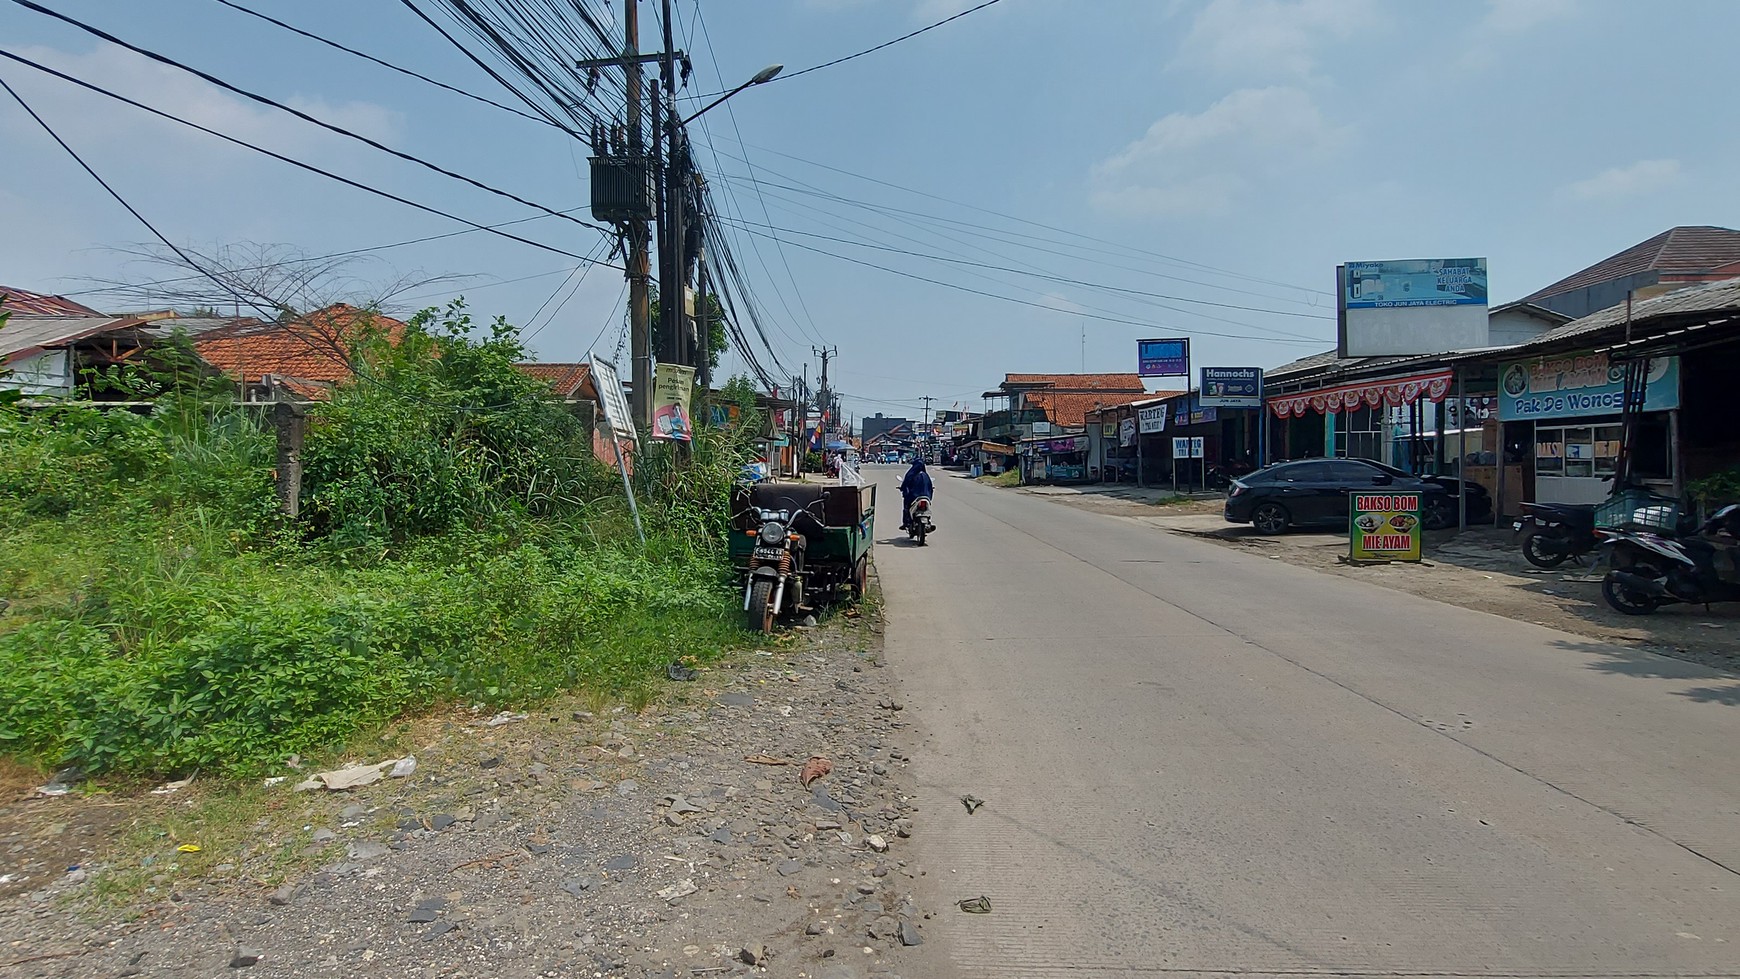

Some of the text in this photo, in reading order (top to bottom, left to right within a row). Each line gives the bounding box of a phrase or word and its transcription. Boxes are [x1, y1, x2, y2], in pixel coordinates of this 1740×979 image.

[1438, 268, 1471, 276] SAHABAT
[1437, 277, 1473, 285] KELUARGA
[1444, 285, 1466, 293] ANDA
[1206, 369, 1255, 378] Hannochs
[1515, 397, 1541, 414] Pak
[1544, 395, 1563, 411] De
[1356, 496, 1418, 511] BAKSO BOM
[1362, 535, 1411, 550] MIE AYAM
